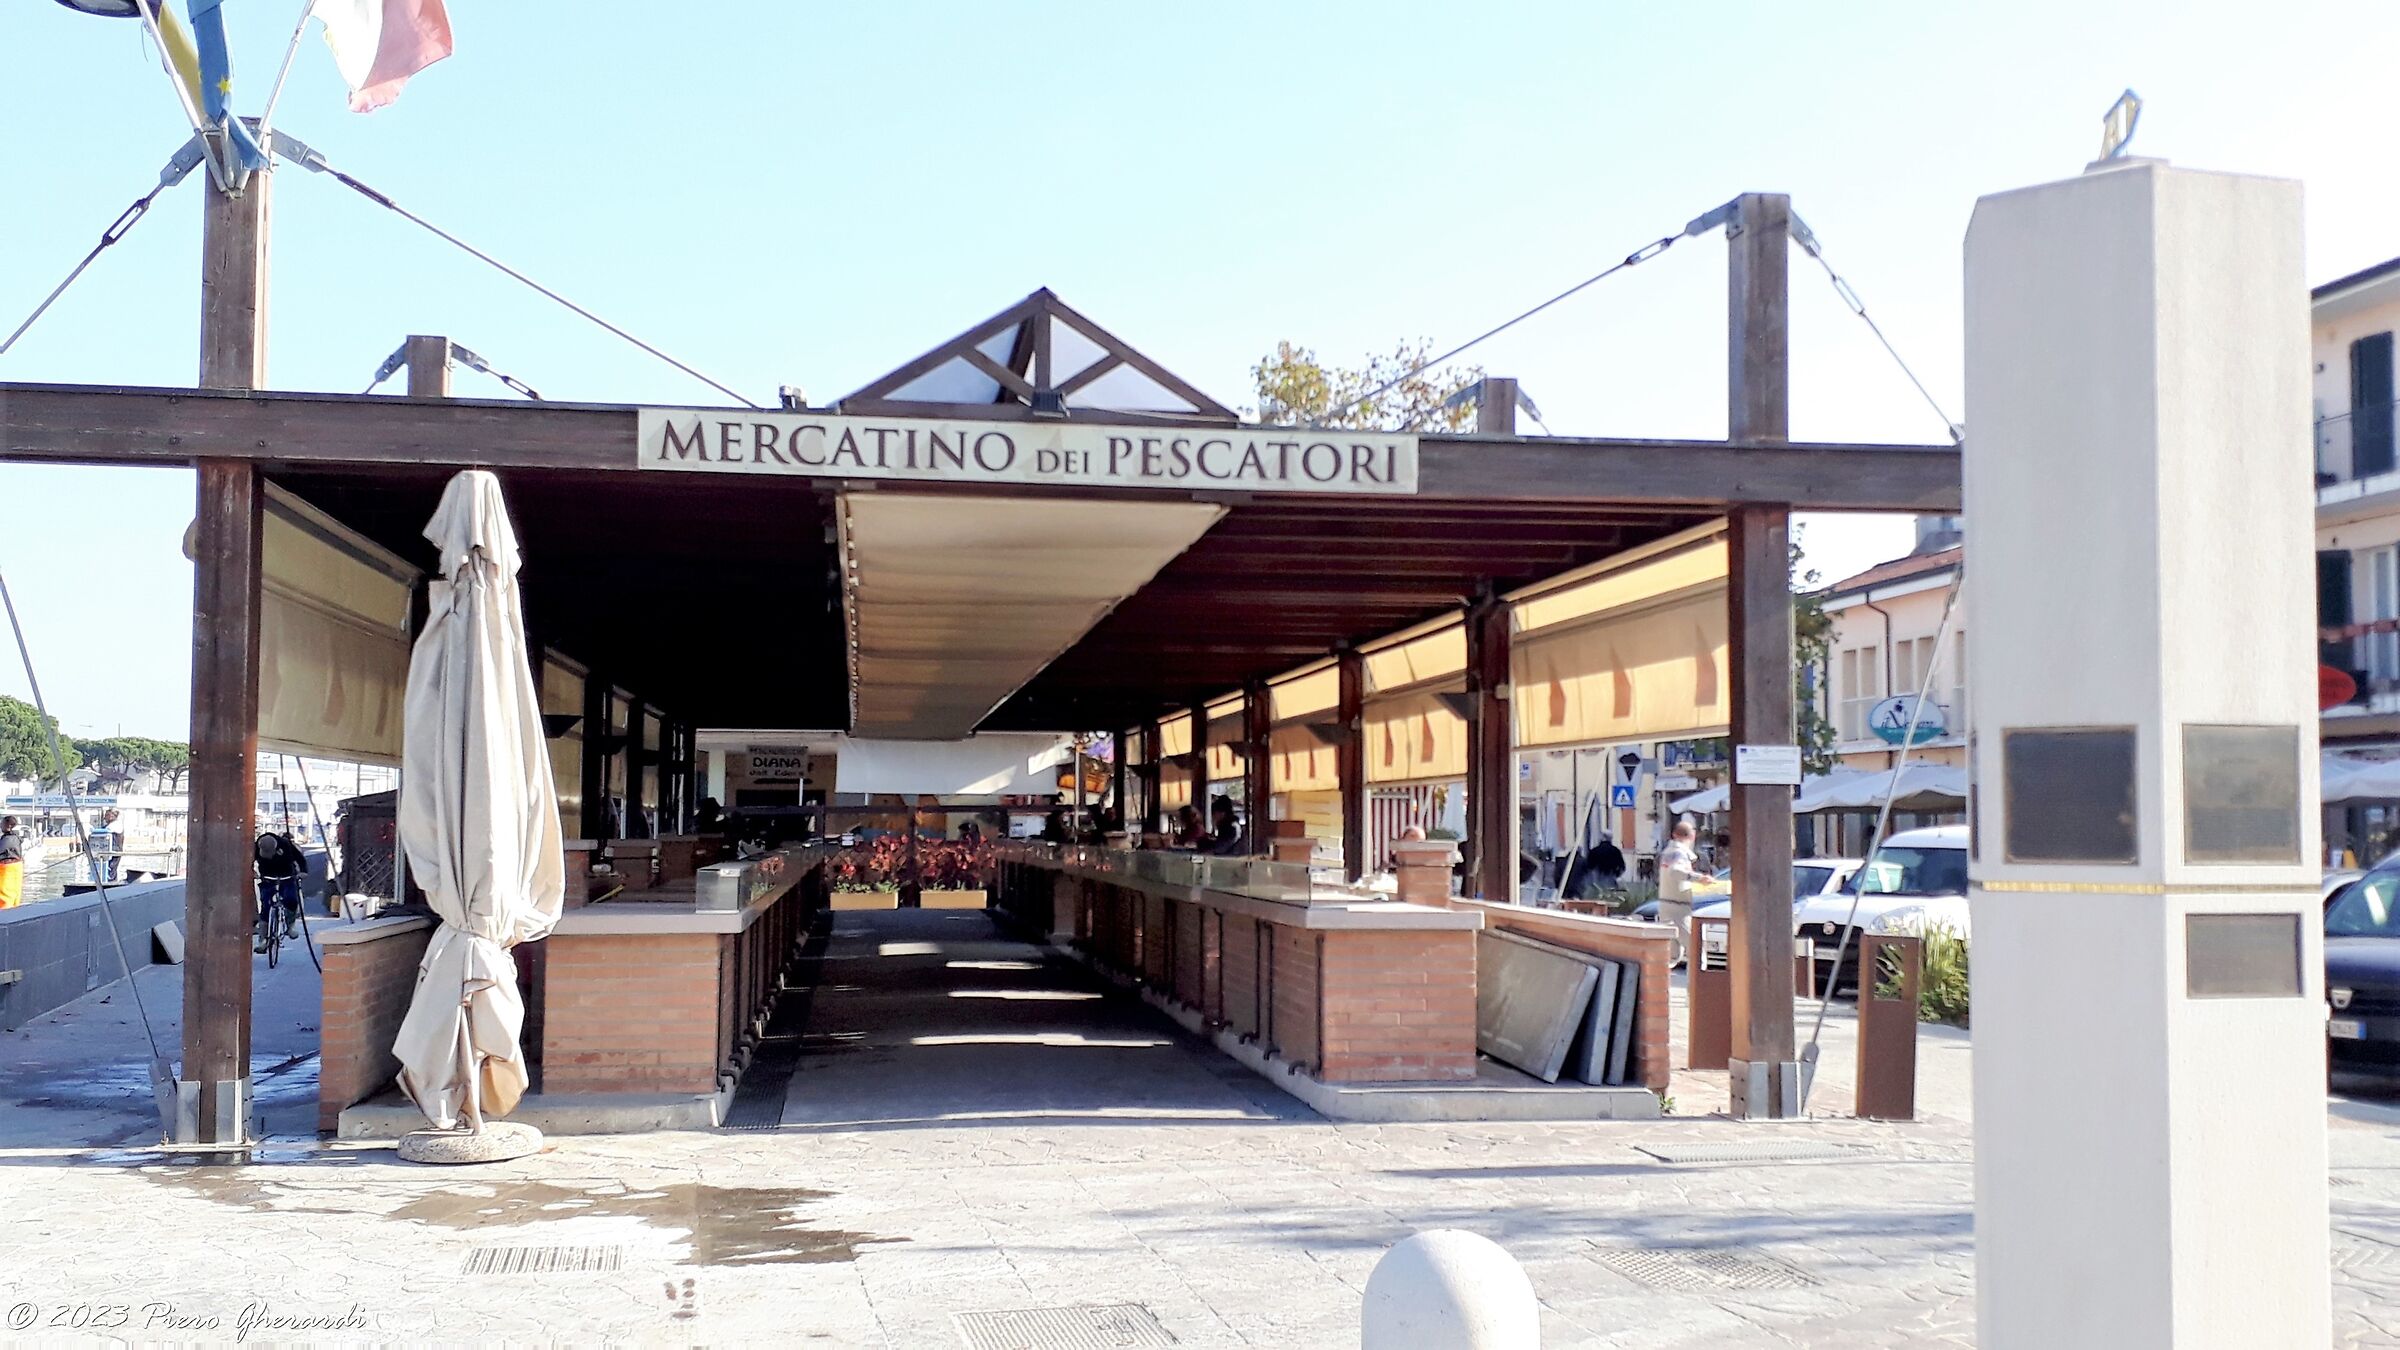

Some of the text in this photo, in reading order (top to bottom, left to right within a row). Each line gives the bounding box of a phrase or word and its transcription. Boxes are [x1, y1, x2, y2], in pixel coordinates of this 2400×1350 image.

[657, 419, 1400, 484] MERCATINO DEI PESCATORI
[752, 756, 801, 768] DIANA
